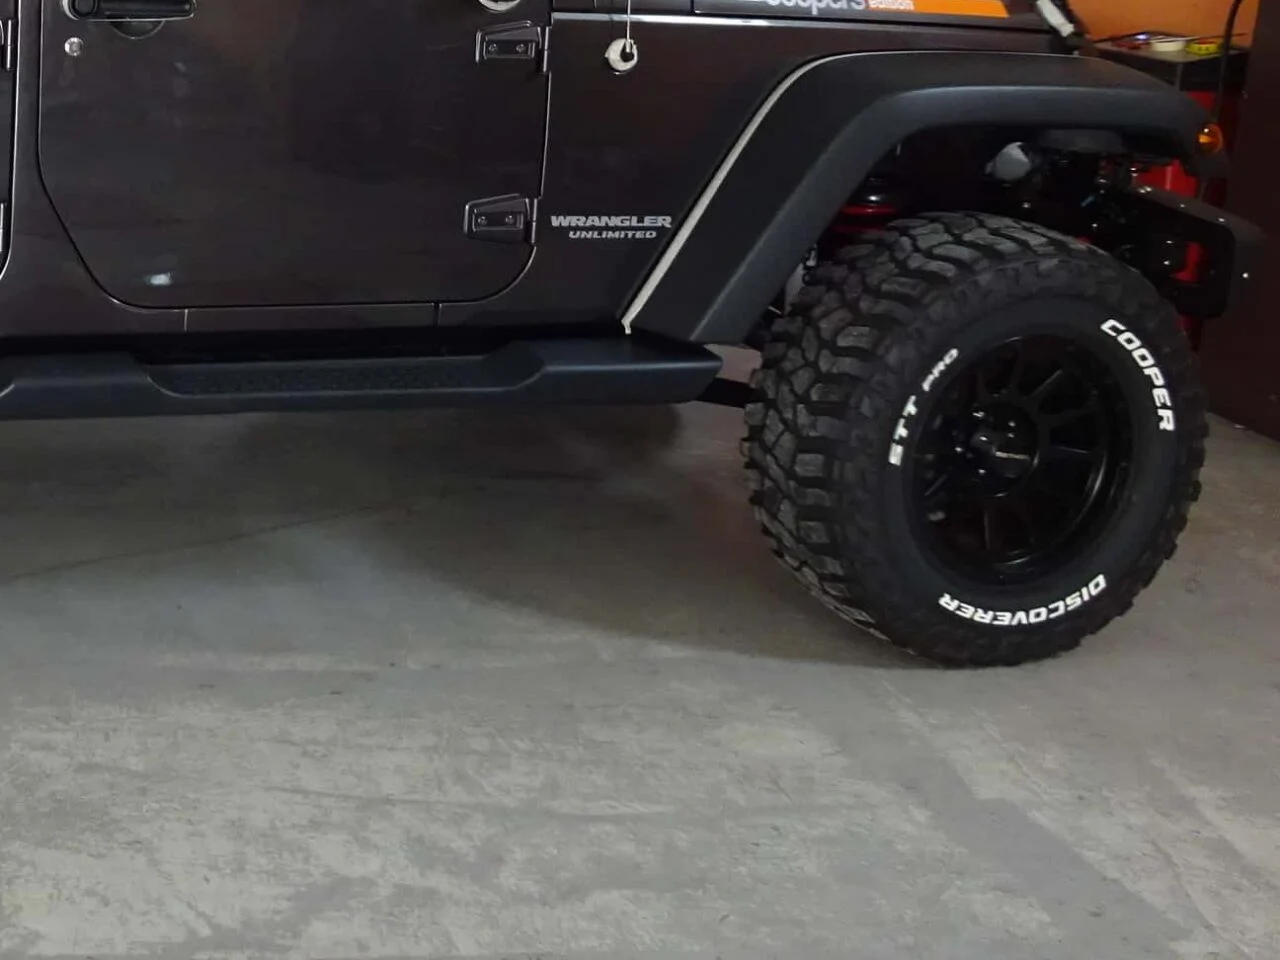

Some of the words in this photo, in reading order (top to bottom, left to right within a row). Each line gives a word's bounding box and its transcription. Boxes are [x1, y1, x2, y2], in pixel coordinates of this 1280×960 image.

[551, 215, 672, 228] WRANGLER
[569, 230, 656, 239] UNLIMITED
[1100, 319, 1175, 431] COOPER
[888, 395, 918, 466] STT
[922, 348, 959, 391] PRO
[938, 573, 1107, 626] DISCOVERER
